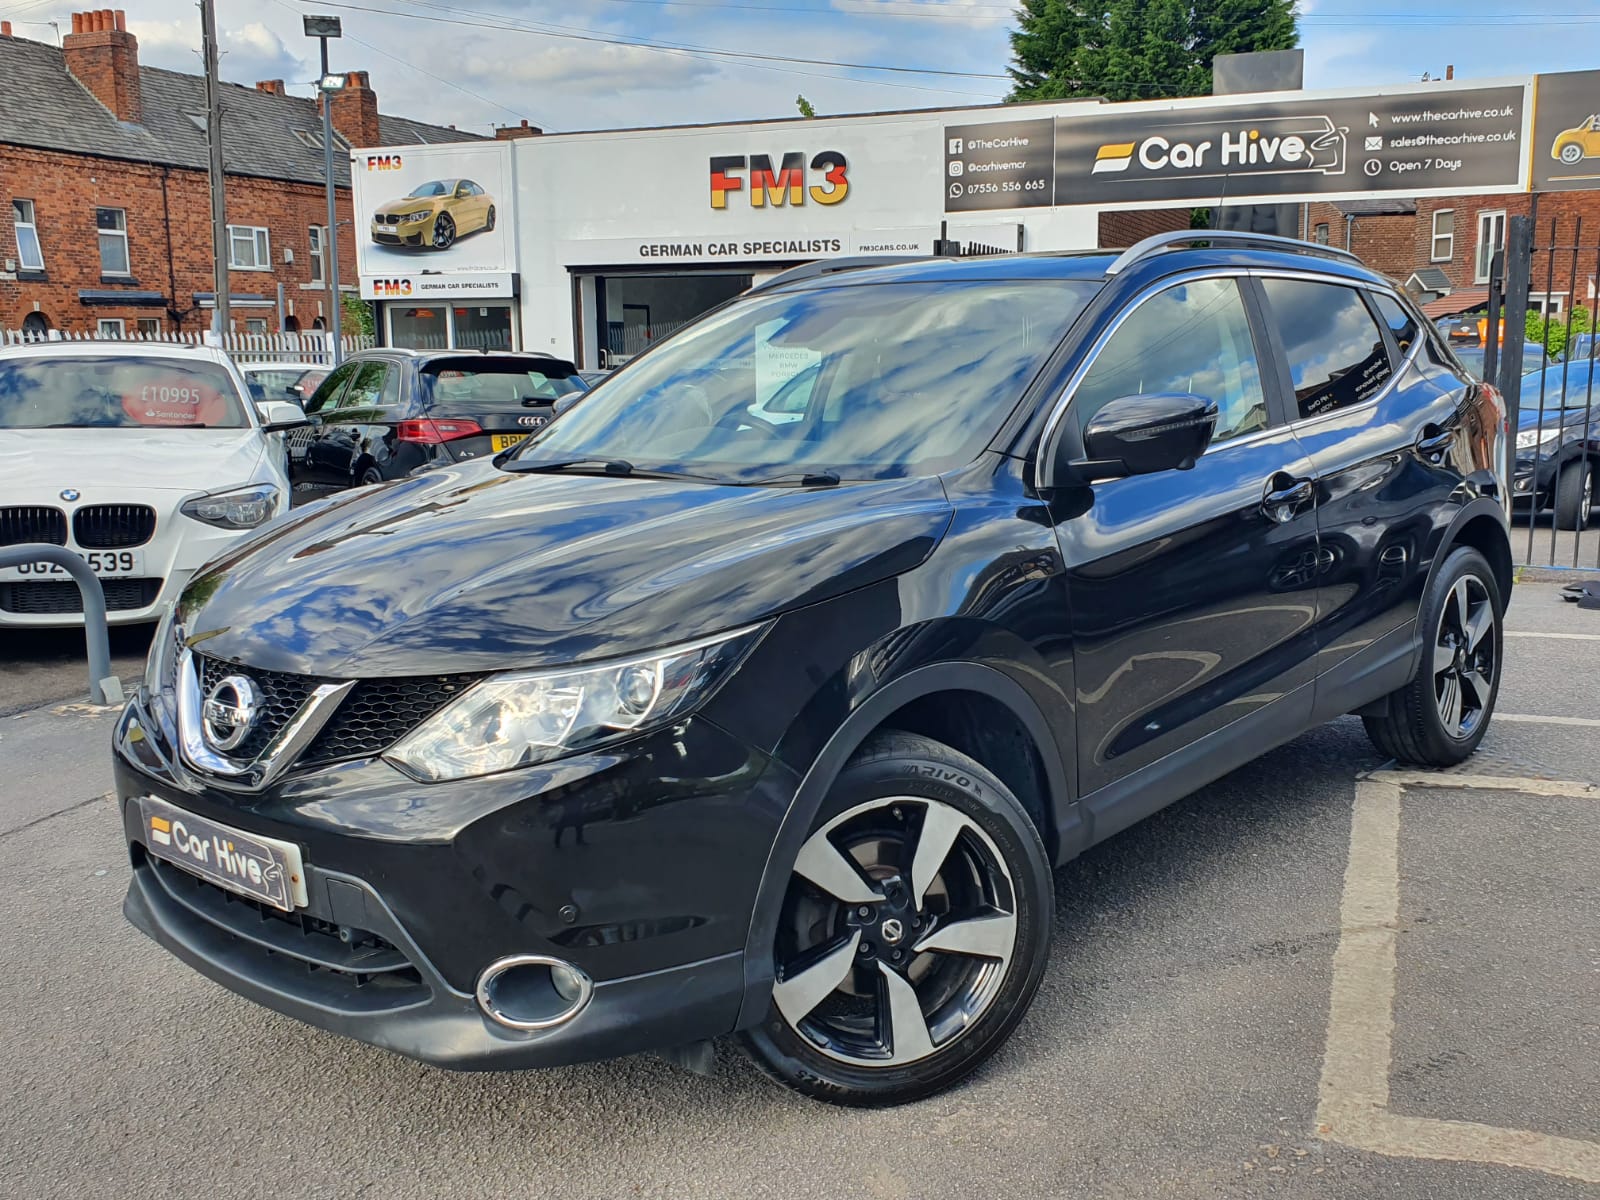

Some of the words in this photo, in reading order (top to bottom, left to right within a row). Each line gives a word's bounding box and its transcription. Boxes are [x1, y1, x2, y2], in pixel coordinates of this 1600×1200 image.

[1391, 105, 1513, 124] www.thecarhive.co.uk
[967, 136, 1029, 150] @TheCarHive
[1390, 129, 1516, 148] sales@thecarhive.co.uk
[1138, 136, 1211, 170] Car
[1221, 130, 1305, 166] Hive
[367, 155, 403, 171] FM3
[967, 160, 1027, 173] @carhivemcr
[1389, 160, 1421, 174] Open
[1423, 159, 1432, 170] 7
[1435, 157, 1462, 171] Days
[709, 150, 850, 209] FM3
[967, 183, 998, 194] 07556
[1002, 181, 1022, 193] 556
[1024, 179, 1046, 191] 665
[639, 243, 703, 257] GERMAN
[707, 242, 738, 256] CAR
[743, 239, 841, 255] SPECIALISTS
[859, 243, 920, 253] FM3CARS.CO.UK
[373, 279, 413, 296] FM3
[420, 283, 446, 291] GERMAN
[447, 282, 460, 290] CAR
[461, 282, 499, 290] SPECIALISTS
[141, 386, 200, 404] £10995
[155, 410, 196, 420] Santander
[500, 435, 521, 448] BP
[78, 552, 133, 572] 539
[903, 764, 971, 788] ARIVO
[172, 820, 210, 863] Car
[213, 836, 262, 885] Hive
